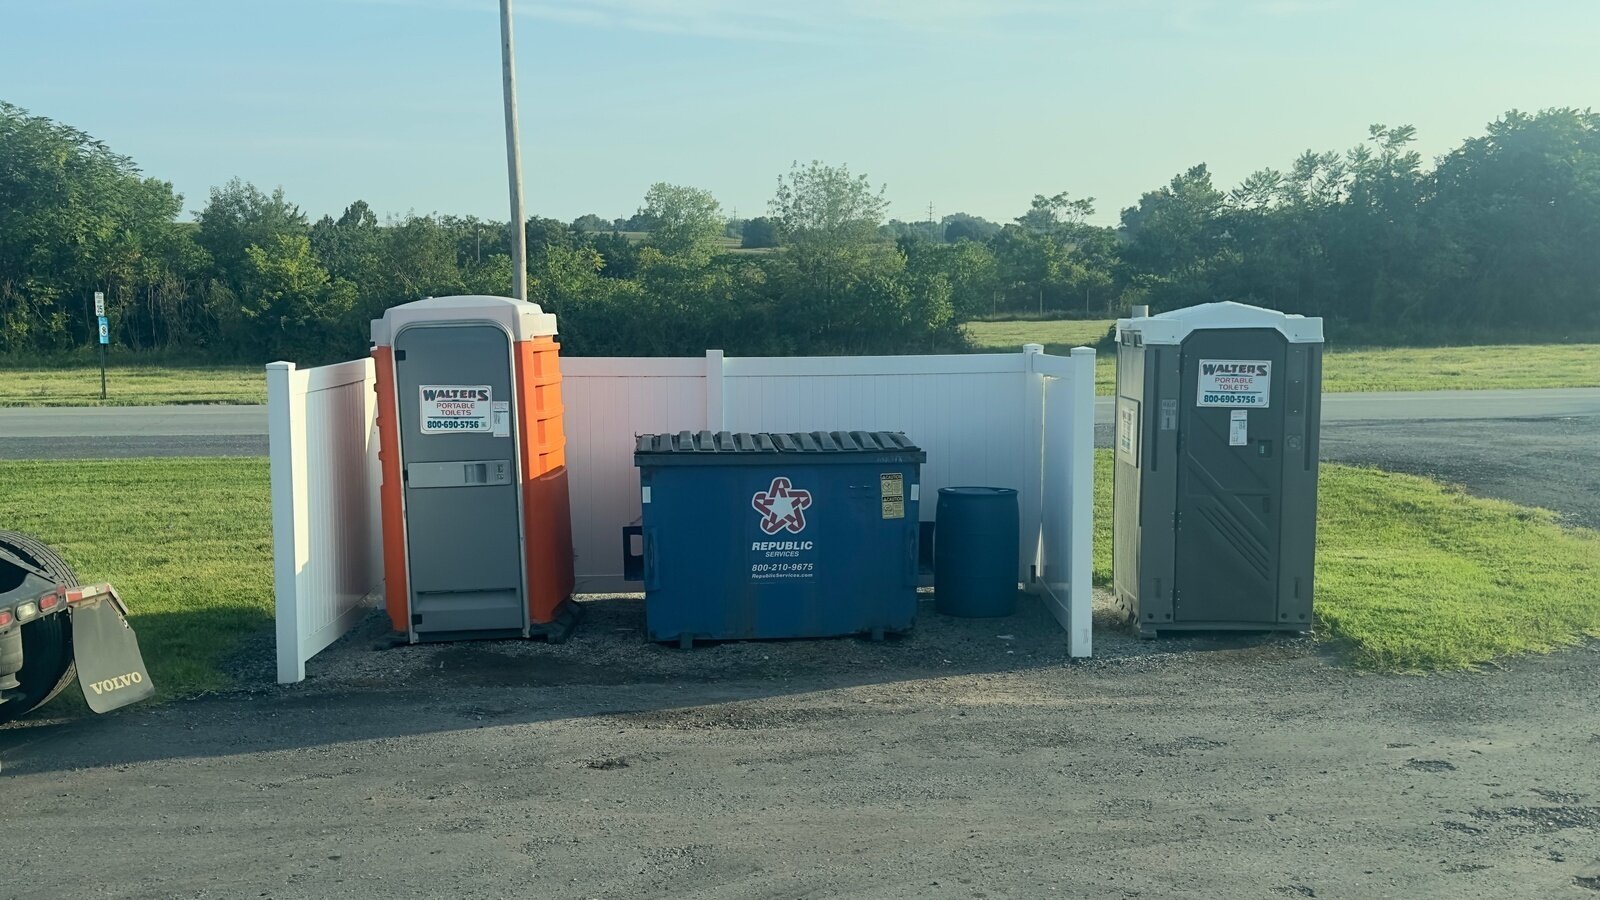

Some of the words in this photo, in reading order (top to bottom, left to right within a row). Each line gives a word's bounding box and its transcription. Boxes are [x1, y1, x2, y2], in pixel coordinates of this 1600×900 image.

[1203, 364, 1267, 376] WALTERS
[423, 390, 489, 401] WALTERS
[1204, 395, 1256, 403] 800-690-5756
[427, 420, 479, 428] 800-690-5756
[752, 541, 813, 551] REPUBLIC
[752, 564, 813, 572] 800-210-9675
[89, 671, 142, 695] VOLVO
